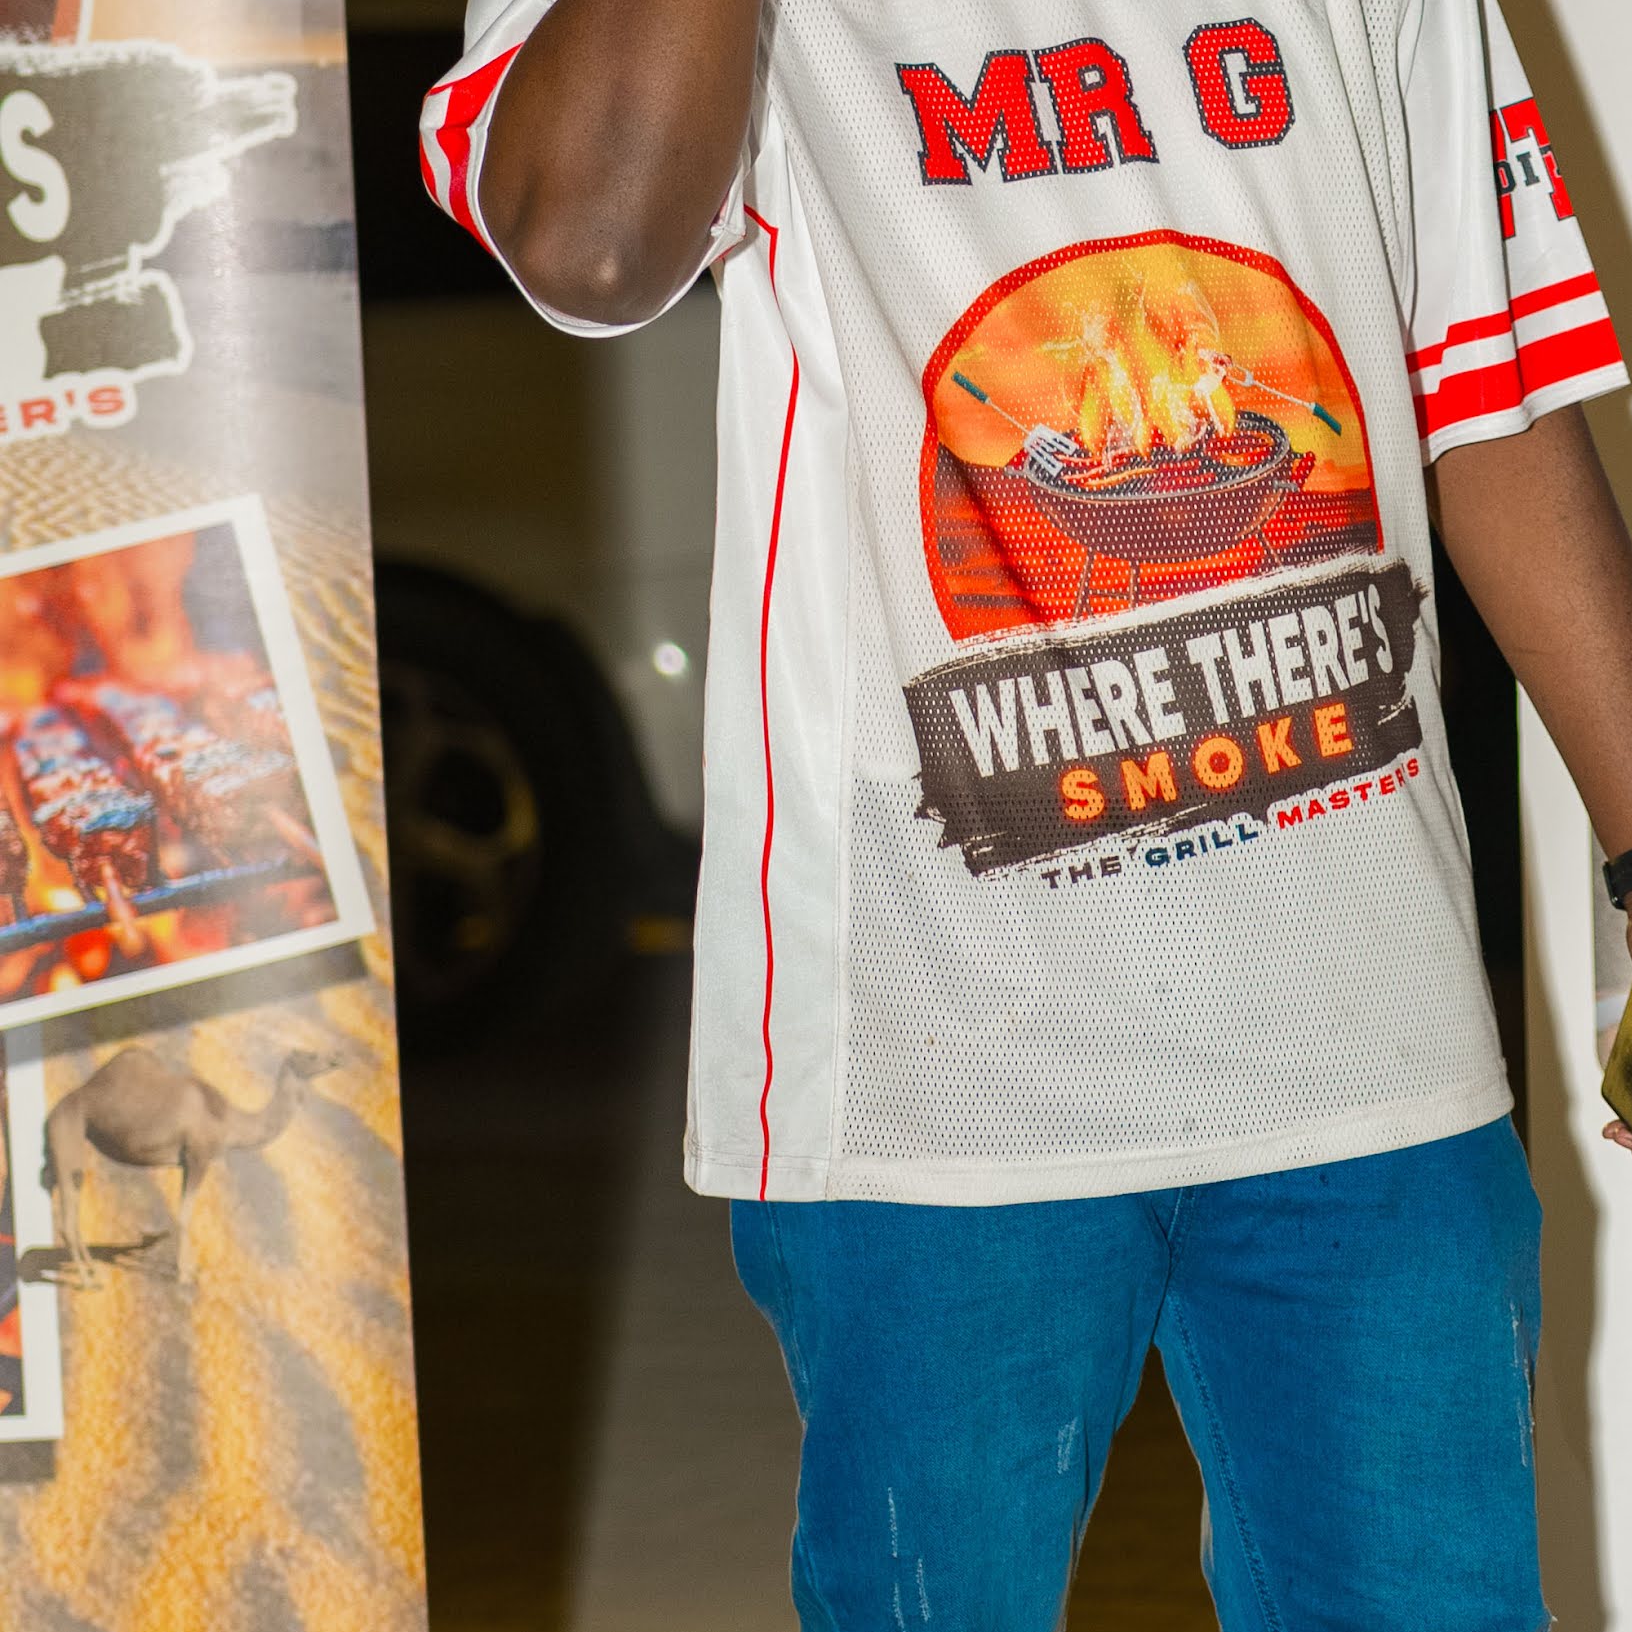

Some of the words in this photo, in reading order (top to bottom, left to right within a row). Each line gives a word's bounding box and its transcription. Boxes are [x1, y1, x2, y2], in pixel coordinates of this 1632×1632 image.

[895, 37, 1160, 187] MR
[1183, 17, 1296, 150] G
[0, 385, 125, 434] R'S
[949, 648, 1186, 778] WHERE
[1187, 583, 1394, 725] THERE'S
[1060, 702, 1353, 821] SMOKE
[1041, 855, 1122, 890] THE
[1145, 823, 1258, 868] GRILL
